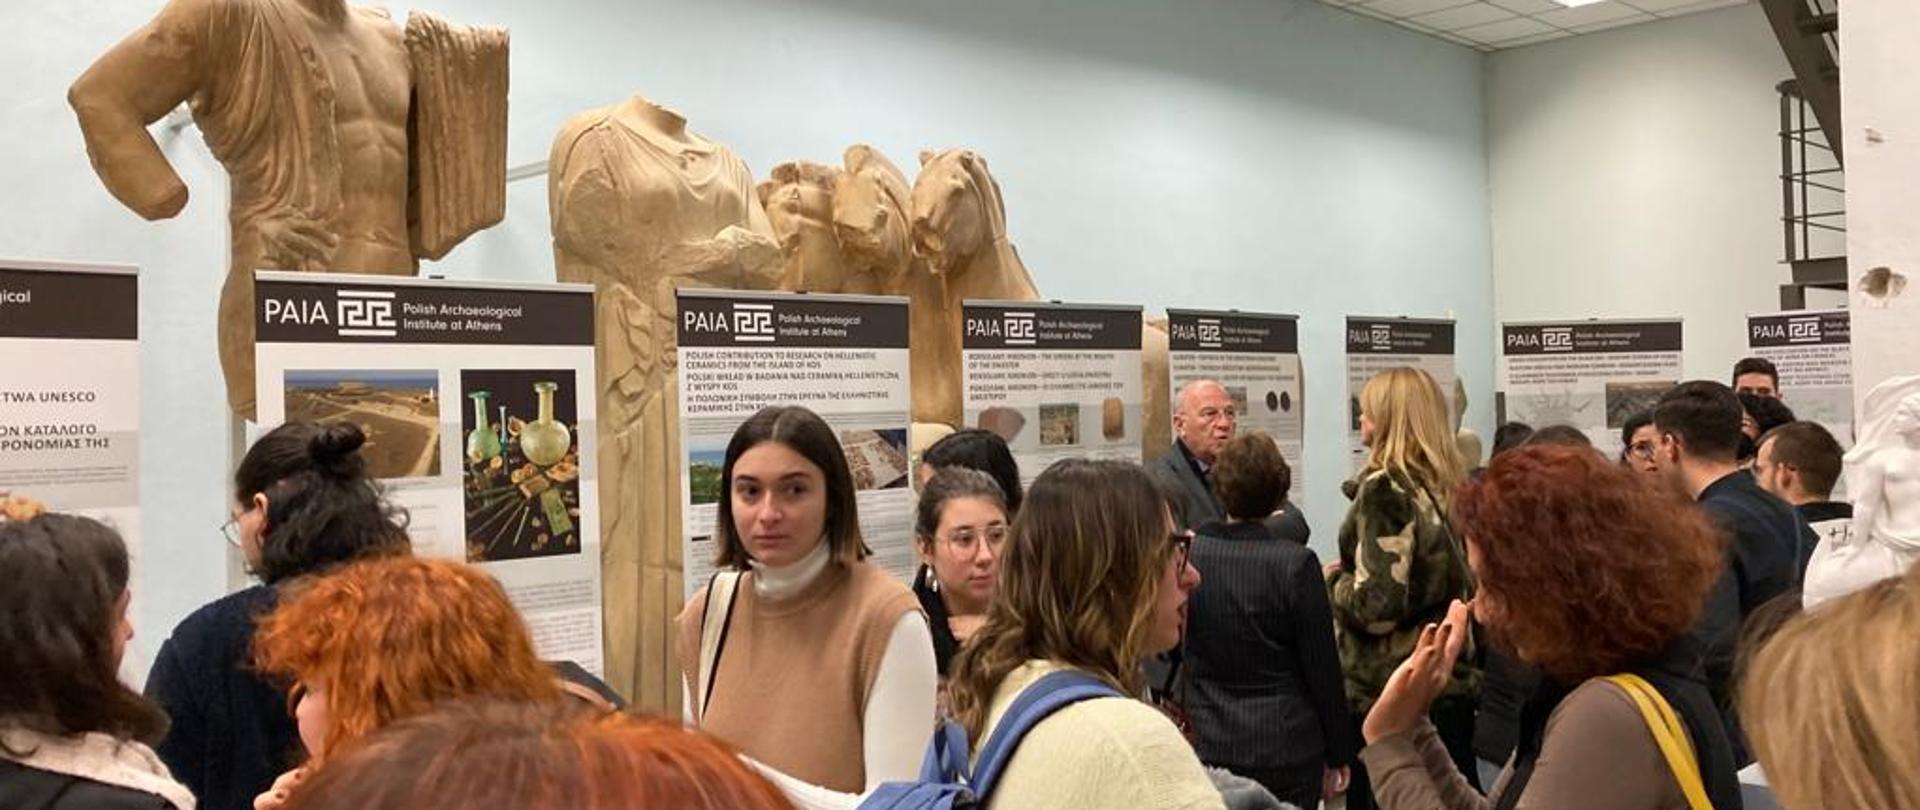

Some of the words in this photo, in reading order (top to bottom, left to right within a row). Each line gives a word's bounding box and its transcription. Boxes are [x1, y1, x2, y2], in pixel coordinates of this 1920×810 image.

[265, 298, 330, 325] PAIA
[403, 302, 436, 315] Polish
[440, 304, 523, 320] Archaeological
[778, 313, 803, 324] Polish
[404, 319, 448, 331] Institute
[451, 321, 463, 331] at
[465, 320, 503, 332] Athens
[684, 311, 729, 332] PAIA
[967, 319, 1002, 338] PAIA
[1171, 323, 1197, 342] PAIA
[1753, 324, 1786, 340] PAIA
[1506, 333, 1540, 348] PAIA
[686, 352, 714, 360] POLISH
[0, 392, 36, 402] TWA
[39, 392, 96, 402] UNESCO
[24, 424, 97, 436] ΚΑΤΑΛΟΓΟ
[85, 437, 110, 448] ΤΗΣ
